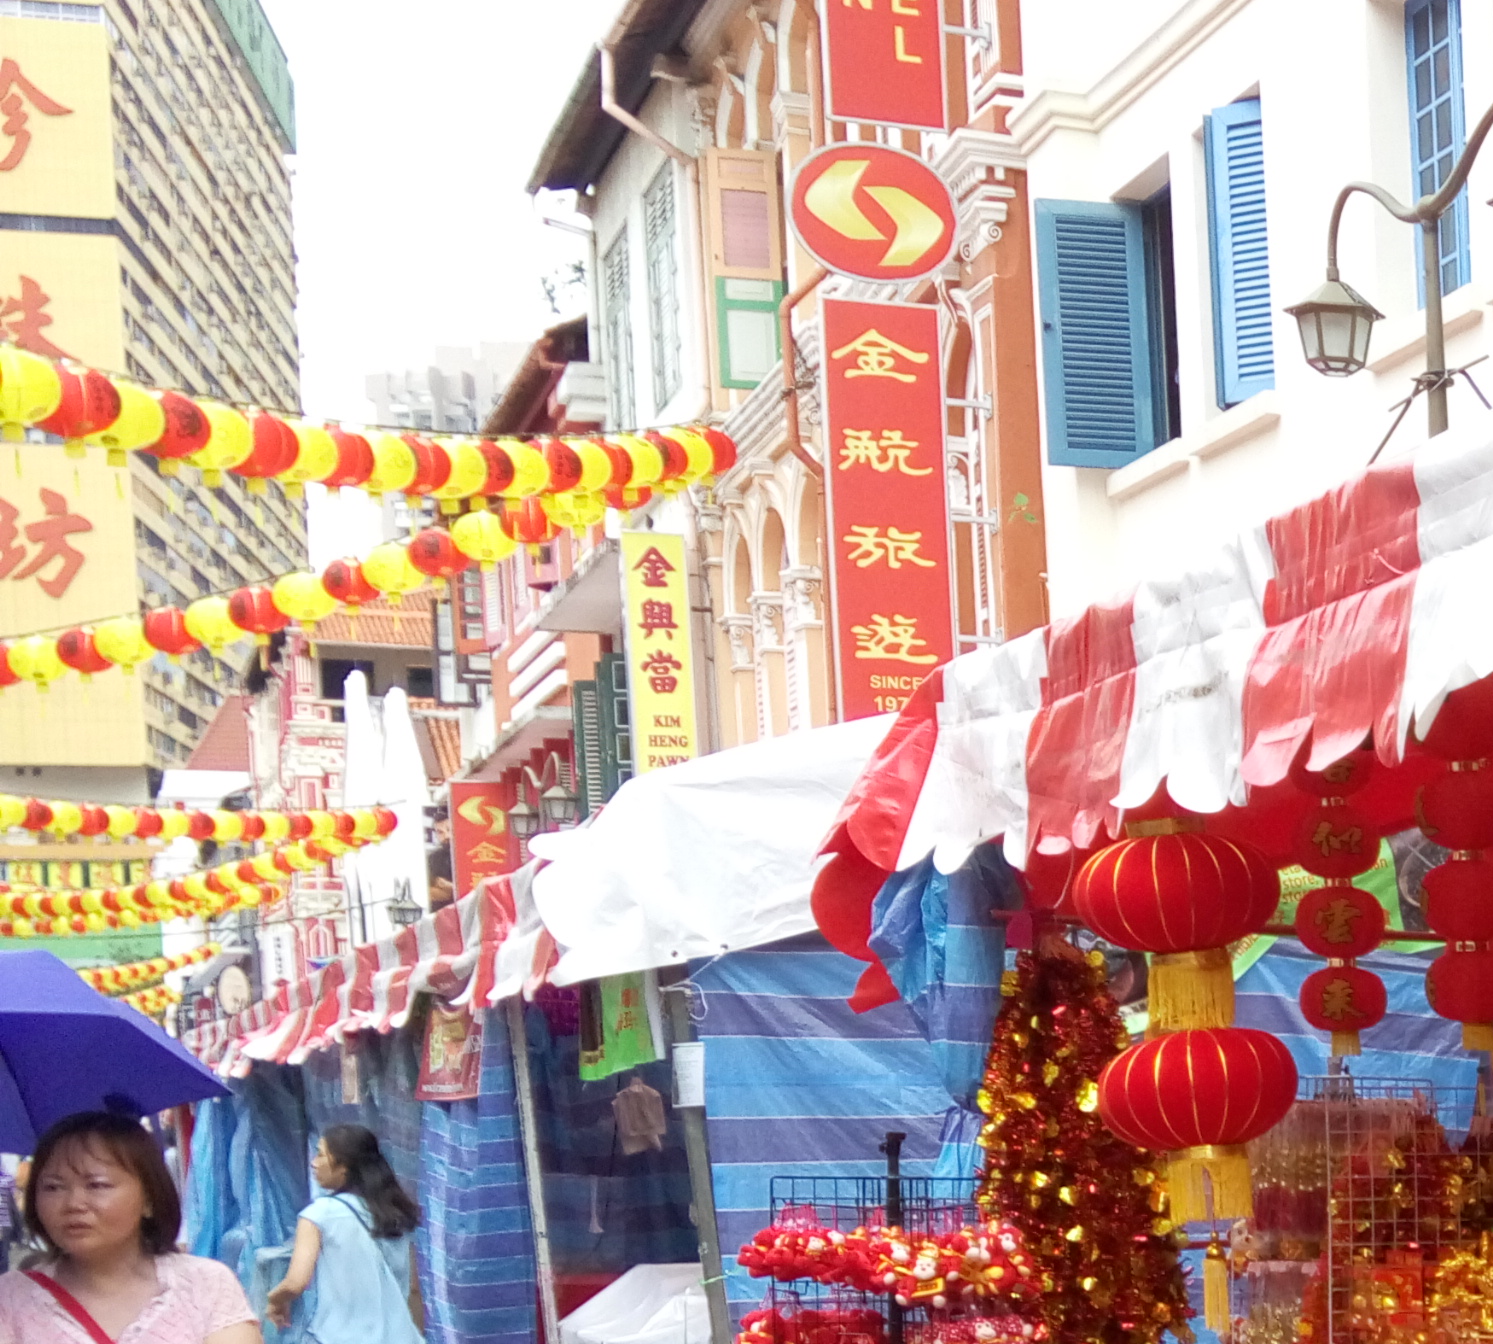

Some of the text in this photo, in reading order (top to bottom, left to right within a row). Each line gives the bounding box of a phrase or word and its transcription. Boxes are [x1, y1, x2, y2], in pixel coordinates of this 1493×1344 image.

[633, 546, 683, 694] 金興當
[873, 696, 910, 713] 197
[654, 715, 682, 728] KIM
[648, 734, 688, 748] HENG
[1282, 890, 1307, 904] sto
